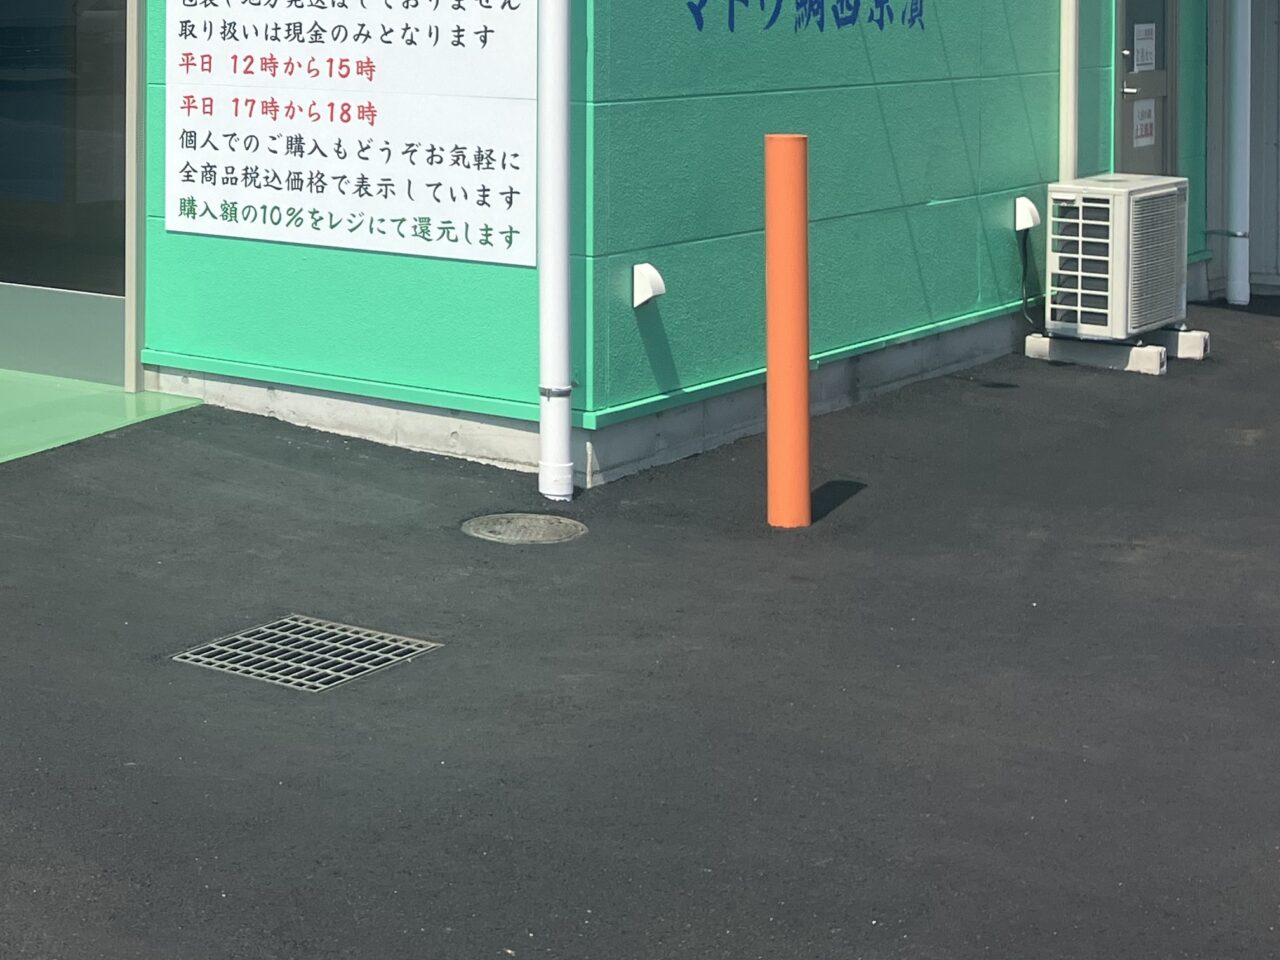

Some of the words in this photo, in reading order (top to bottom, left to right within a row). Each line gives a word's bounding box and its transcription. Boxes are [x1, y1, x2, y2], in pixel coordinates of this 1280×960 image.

[178, 19, 496, 49] 取り扱いは現金のみとなります
[179, 52, 213, 74] 平日
[230, 53, 376, 82] 12時から15時
[180, 95, 214, 117] 平日
[231, 97, 377, 126] 17時から18時
[179, 128, 521, 171] 個人でのご購入もどうぞお気軽に
[179, 161, 521, 210] 全商品税込価格で表示しています
[178, 195, 521, 249] 購入額の10%をレジにて還元します
